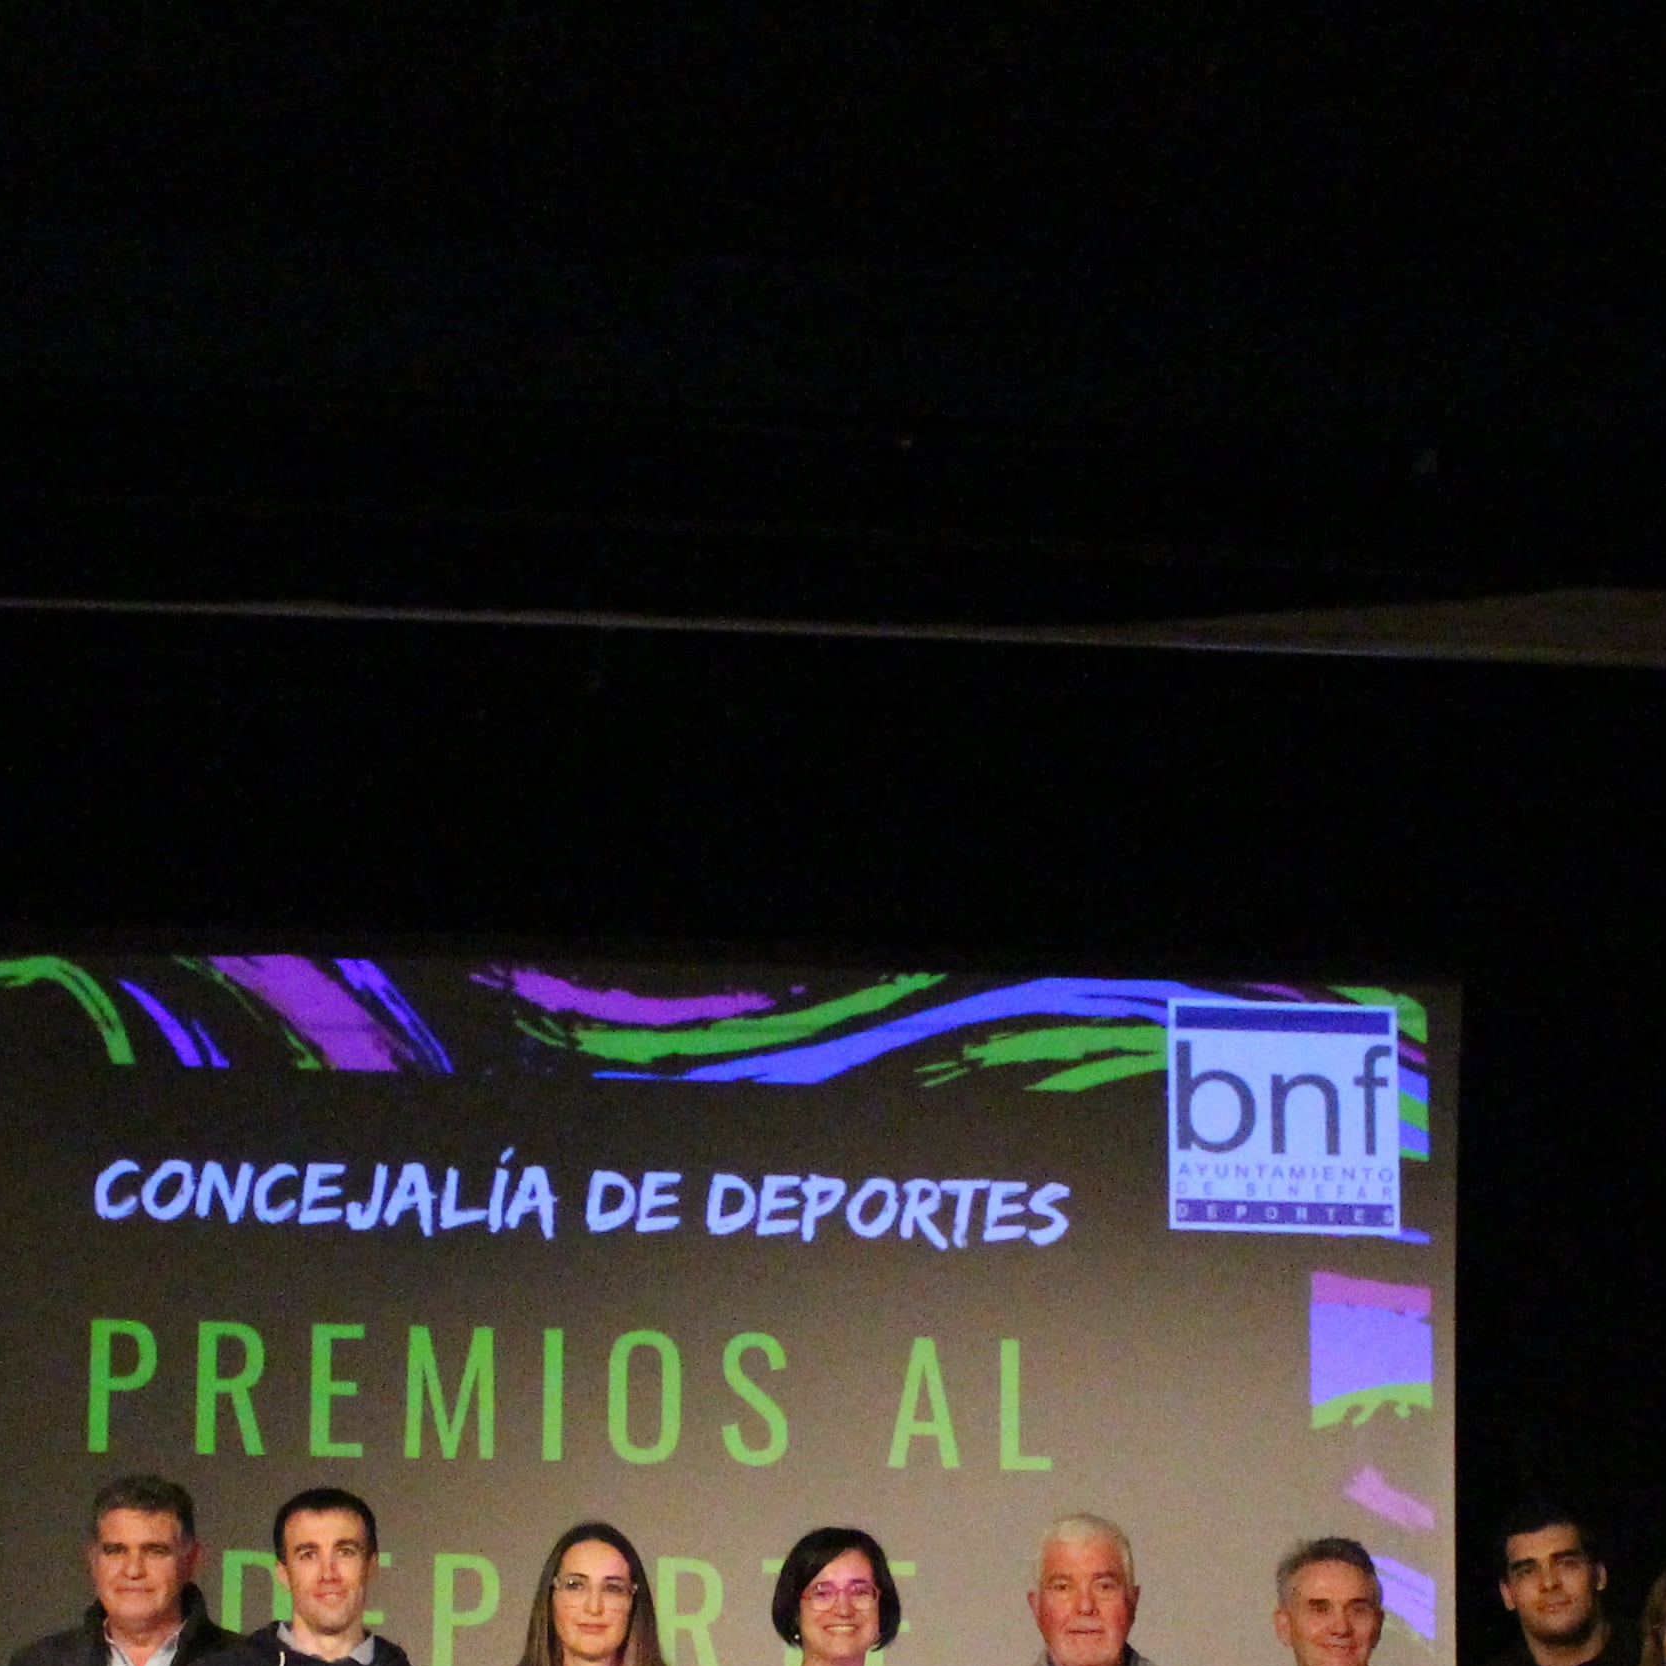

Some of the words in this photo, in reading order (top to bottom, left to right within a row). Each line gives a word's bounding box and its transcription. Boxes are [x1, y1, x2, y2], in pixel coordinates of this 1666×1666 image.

[1176, 1040, 1392, 1155] bnf
[93, 1146, 558, 1240] CONCEJALÍA
[585, 1169, 682, 1233] DE
[706, 1173, 1071, 1250] DEPORTES
[1176, 1203, 1394, 1225] DEPORTES
[1177, 1162, 1394, 1183] AYUNTAMIENTO
[87, 1318, 789, 1467] PREMIOS
[888, 1336, 1053, 1471] AL
